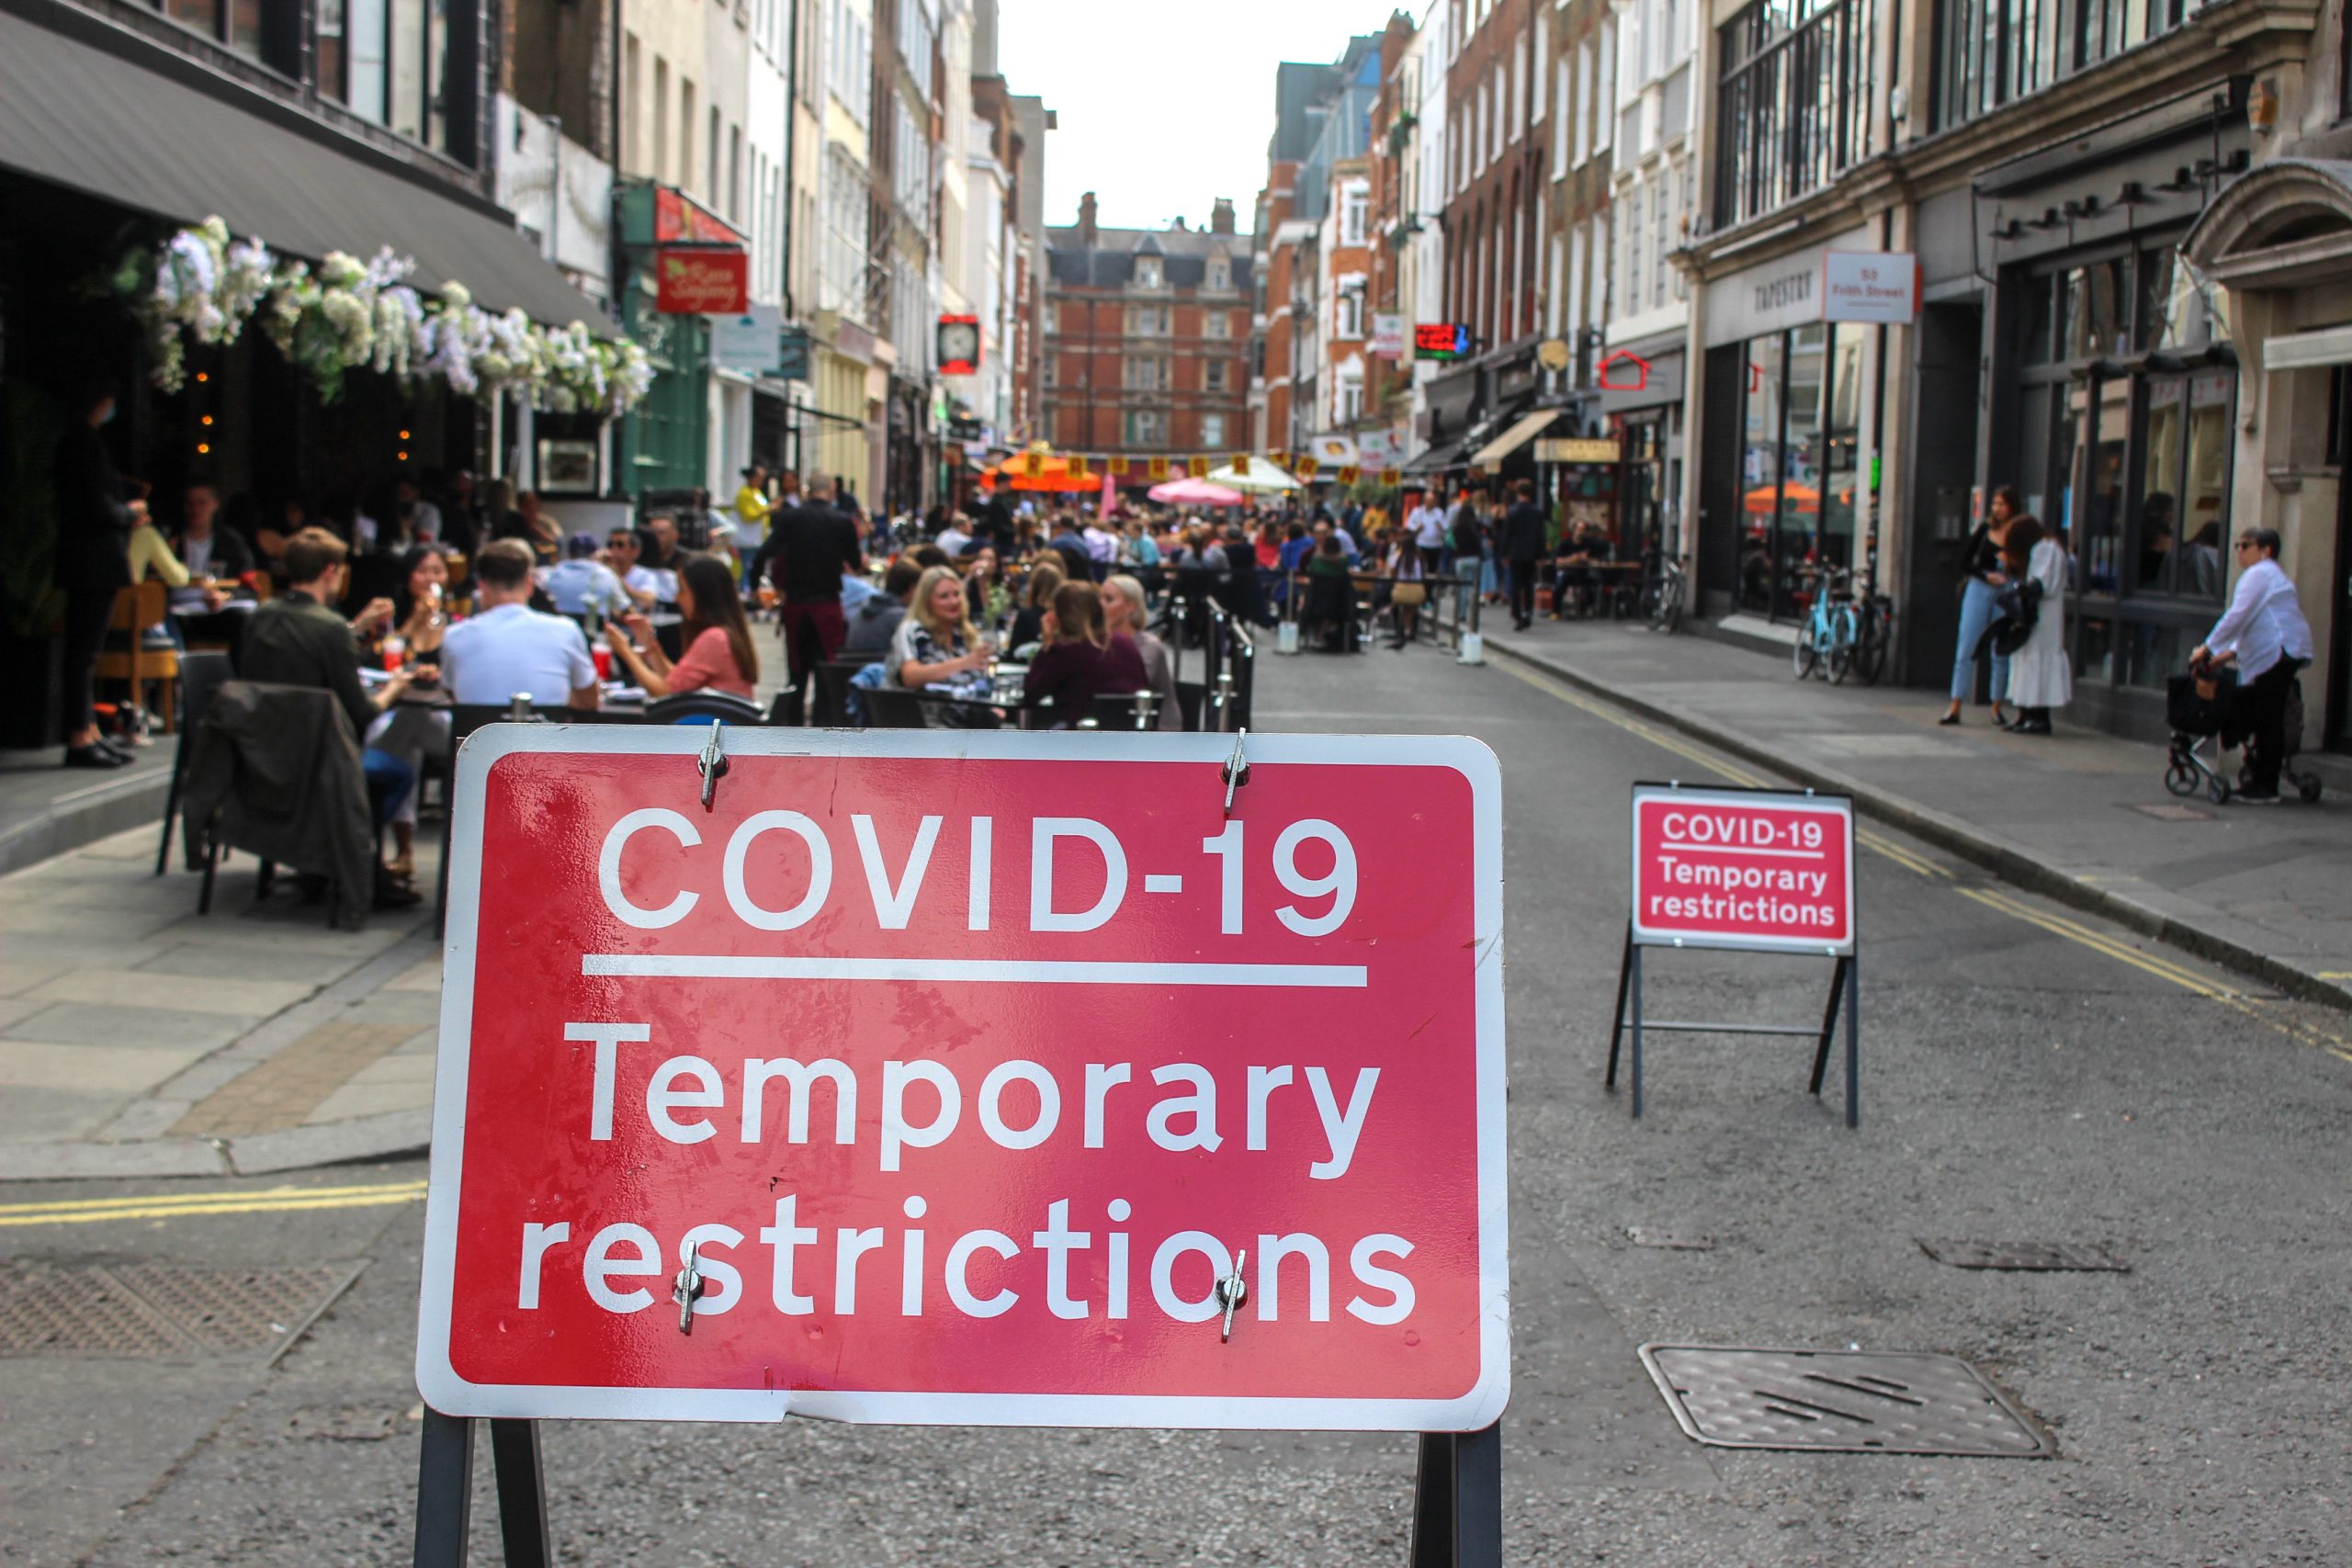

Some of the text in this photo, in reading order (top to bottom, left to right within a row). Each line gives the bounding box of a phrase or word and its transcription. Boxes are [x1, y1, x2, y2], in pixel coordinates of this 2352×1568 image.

[1755, 270, 1813, 313] TAPESTRY
[1866, 284, 1905, 299] Street
[1662, 813, 1824, 848] COVID-19
[598, 808, 1358, 937] COVID-19
[1657, 856, 1828, 897] Temporary
[1651, 892, 1836, 927] restrictions
[563, 1022, 1382, 1180] Temporary
[518, 1194, 1417, 1326] restrictions
